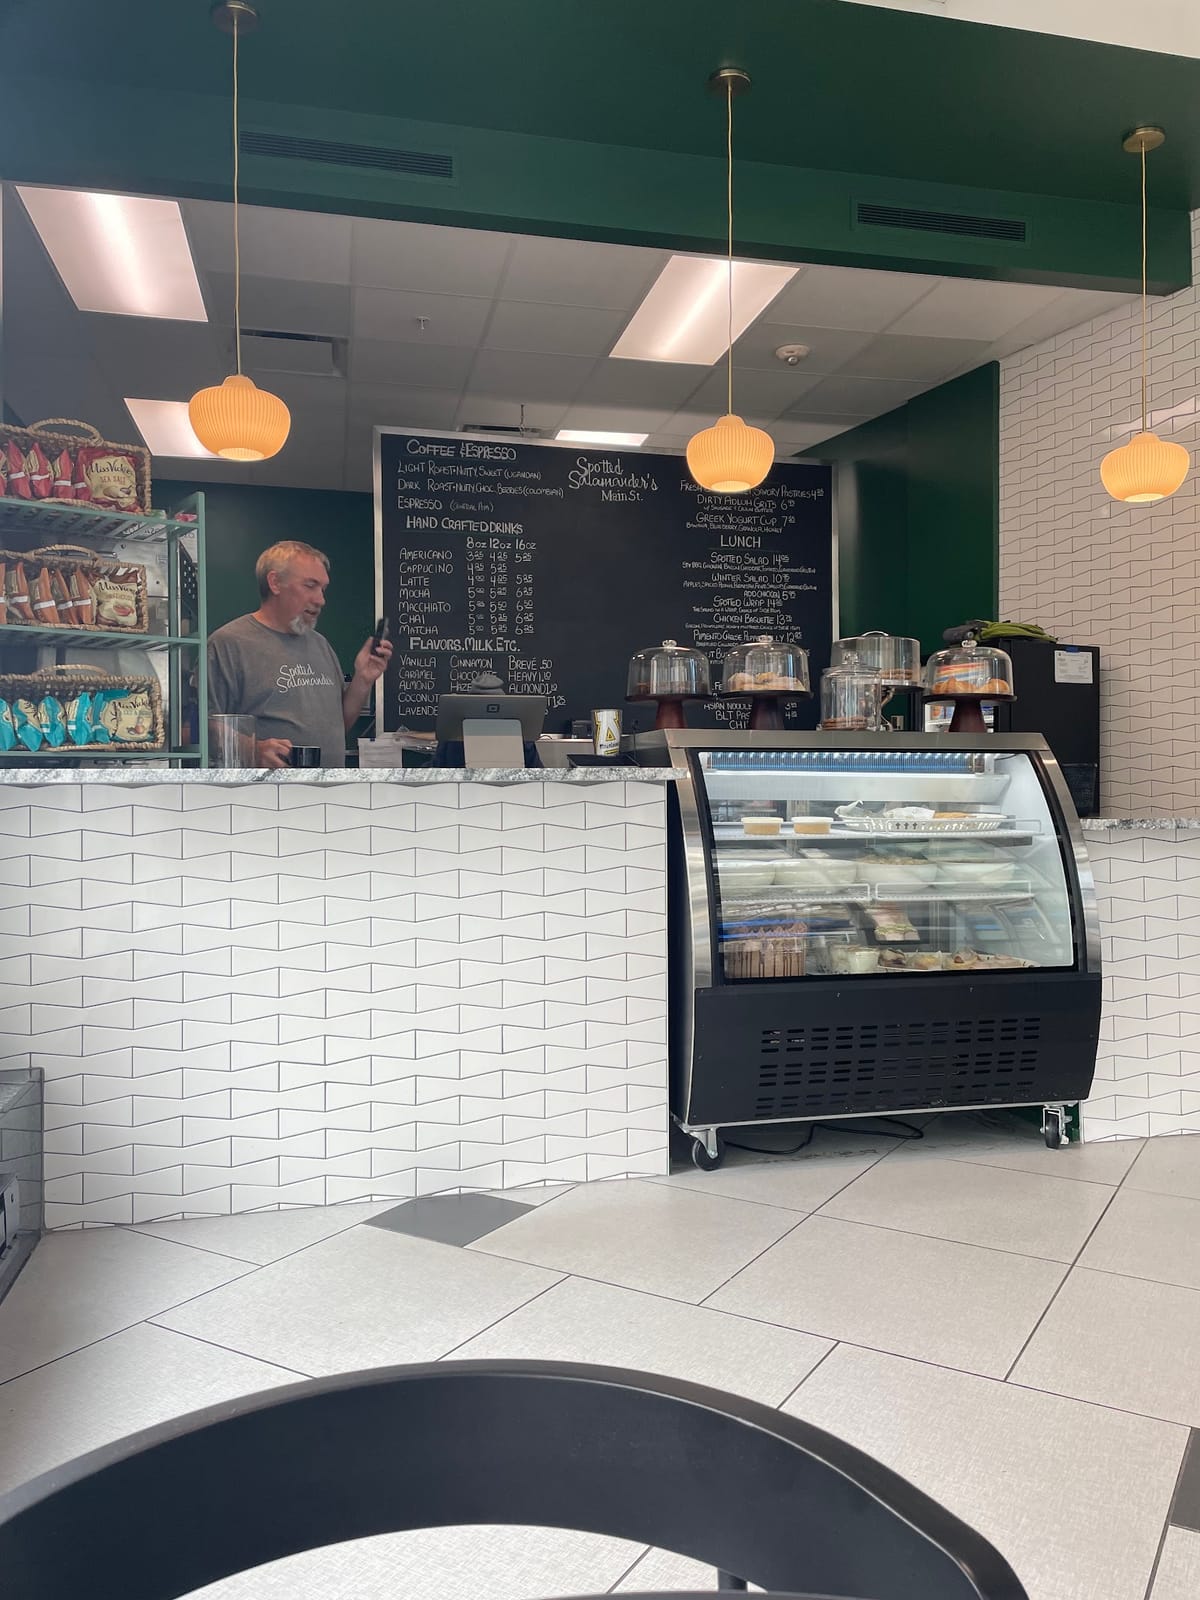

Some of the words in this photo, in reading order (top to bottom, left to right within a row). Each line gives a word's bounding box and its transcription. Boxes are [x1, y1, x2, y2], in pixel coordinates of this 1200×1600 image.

[406, 439, 456, 457] COFFEE
[397, 460, 425, 473] LIGHT
[576, 457, 624, 476] Spotted
[398, 479, 421, 491] DARK
[568, 470, 659, 491] Salamander's
[601, 490, 627, 502] Main
[697, 493, 722, 505] DIRTY
[753, 498, 777, 509] GRITS
[397, 496, 443, 510] ESPRESSO
[406, 515, 438, 529] HAND
[696, 511, 725, 524] GREEK
[727, 513, 759, 525] YOGURT
[760, 514, 777, 527] CUP
[720, 534, 761, 548] LUNCH
[400, 548, 453, 560] AMERICANO
[711, 552, 742, 564] SPOTTED
[743, 553, 769, 565] SALAD
[400, 562, 453, 575] CAPPUCINO
[400, 576, 430, 587] LATTE
[711, 573, 742, 582] WINTER
[743, 573, 769, 583] SALAD
[399, 588, 431, 599] MOCHA
[399, 601, 452, 613] MACCHIATO
[713, 595, 741, 608] SPOTTED
[743, 598, 765, 607] WRAP
[399, 614, 425, 625] CHAI
[713, 613, 743, 624] CHICKEN
[399, 625, 439, 636] MATCHA
[694, 629, 722, 641] PIMENTO
[400, 655, 437, 669] VANILLA
[450, 655, 493, 670] CINNAMON
[279, 664, 315, 681] Spotted
[399, 668, 437, 681] CARAMEL
[450, 669, 498, 681] CHOCO
[508, 671, 537, 683] HEAVY
[399, 680, 435, 691] ALMOND
[450, 683, 473, 692] HAZE
[508, 683, 546, 695] ALMOND
[398, 693, 440, 704] COCONUT
[399, 704, 439, 717] LAVENDE
[703, 702, 725, 711] ASIAN
[715, 710, 734, 721] BLT
